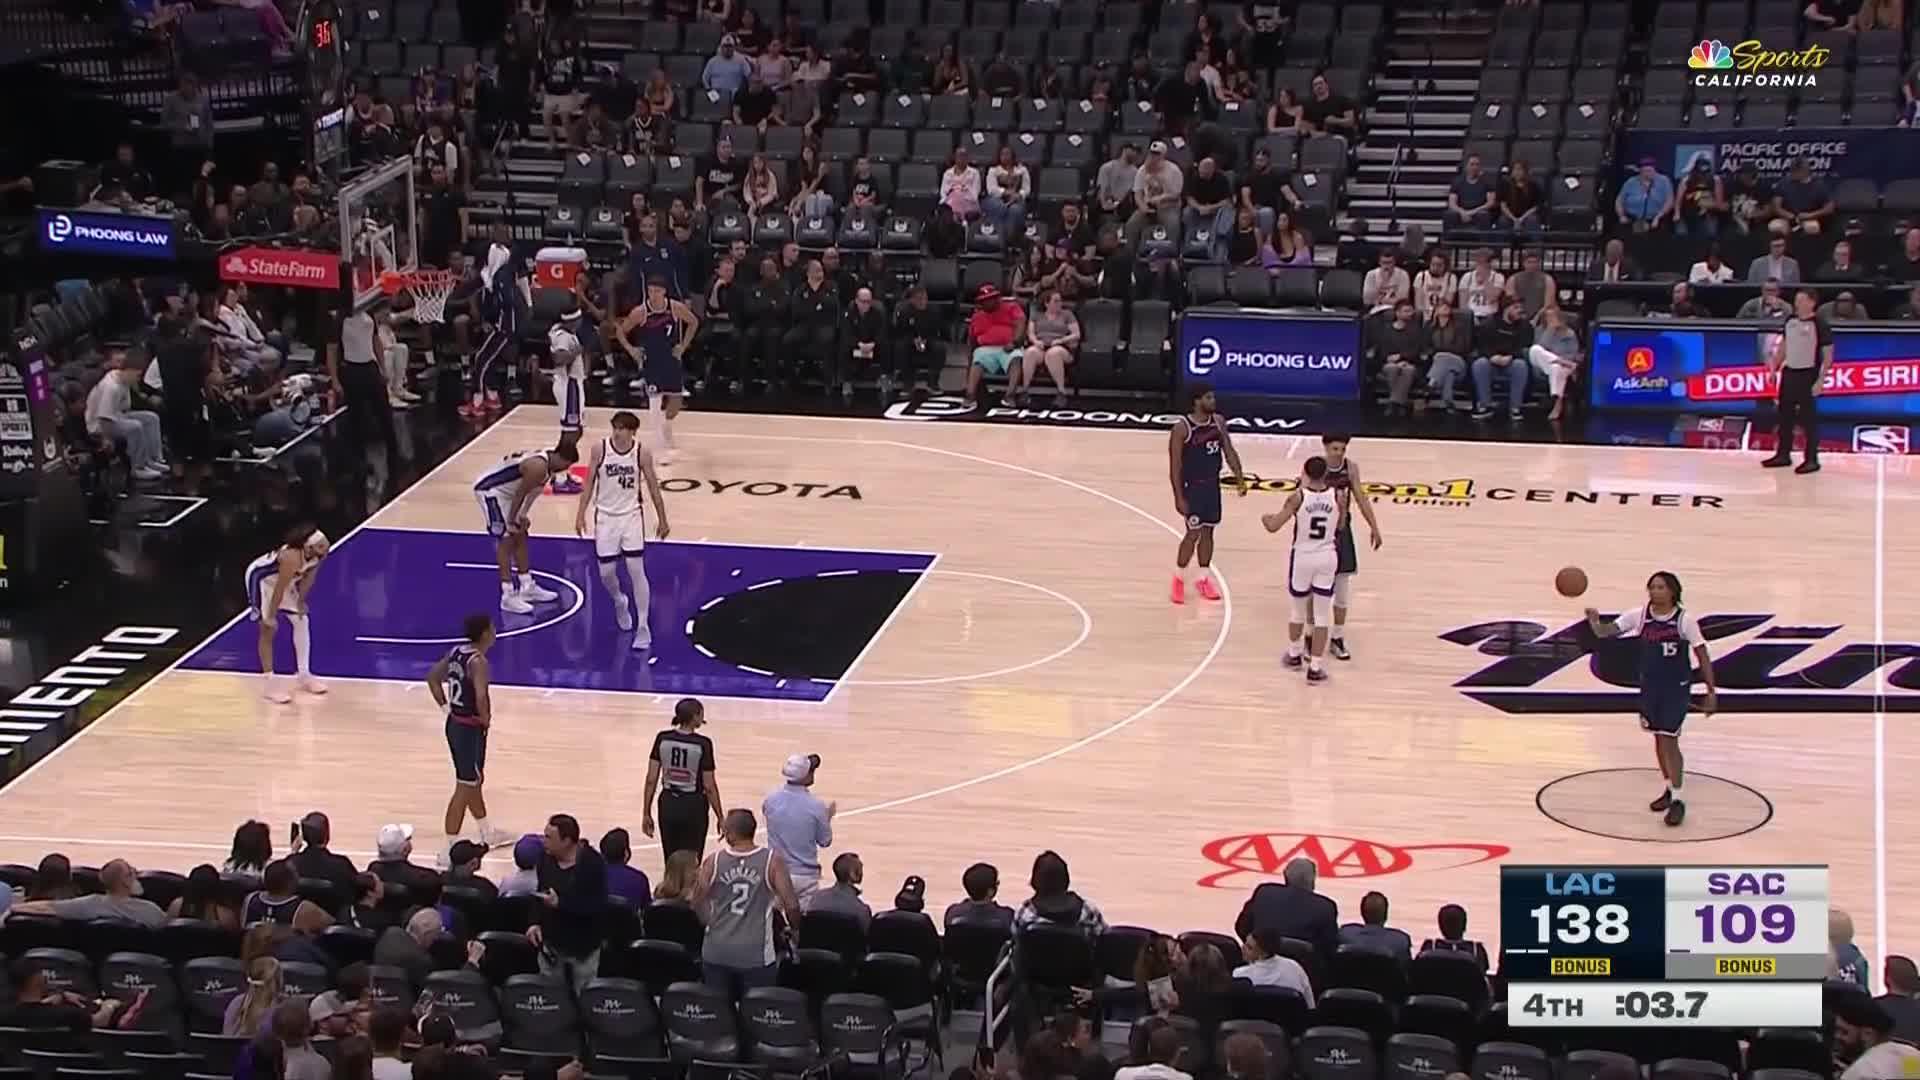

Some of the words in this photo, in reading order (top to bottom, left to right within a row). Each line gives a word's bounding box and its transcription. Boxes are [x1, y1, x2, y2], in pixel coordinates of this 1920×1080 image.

[1720, 143, 1782, 156] PACIFIC
[1787, 142, 1847, 155] OFFICE
[1720, 158, 1832, 172] AUOMAON
[75, 226, 134, 243] PHOONG
[136, 232, 169, 246] LAW
[551, 264, 563, 278] G
[1225, 352, 1304, 369] PHOONG
[1308, 355, 1352, 370] LAW
[1705, 371, 1780, 394] DON'
[1823, 367, 1855, 388] SK
[1862, 364, 1918, 387] SIRI
[1225, 416, 1306, 429] AW
[618, 475, 635, 489] 42
[660, 478, 862, 500] OYOTA
[1486, 487, 1724, 509] CENTER
[1309, 517, 1328, 540] 5
[1661, 641, 1678, 656] 15
[671, 747, 688, 768] 81
[731, 883, 749, 915] 2
